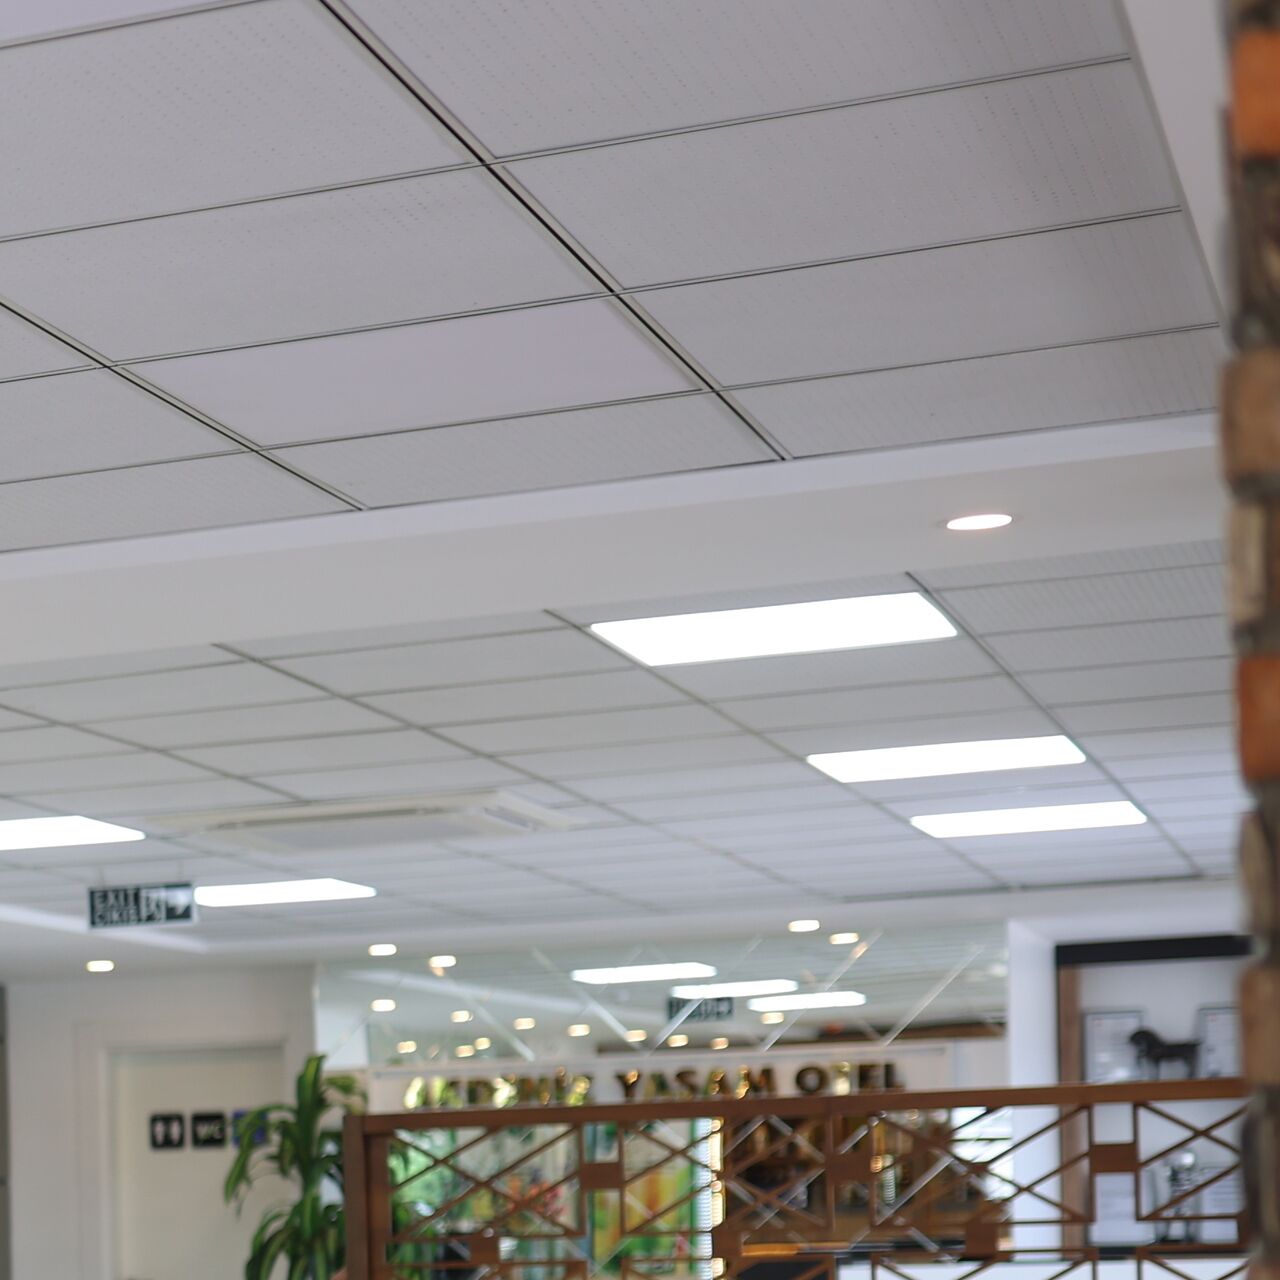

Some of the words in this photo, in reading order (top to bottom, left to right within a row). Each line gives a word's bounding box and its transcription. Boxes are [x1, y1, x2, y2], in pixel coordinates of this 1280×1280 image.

[95, 887, 139, 908] EXIT
[794, 1062, 907, 1096] OTEL
[196, 1122, 224, 1140] WC
